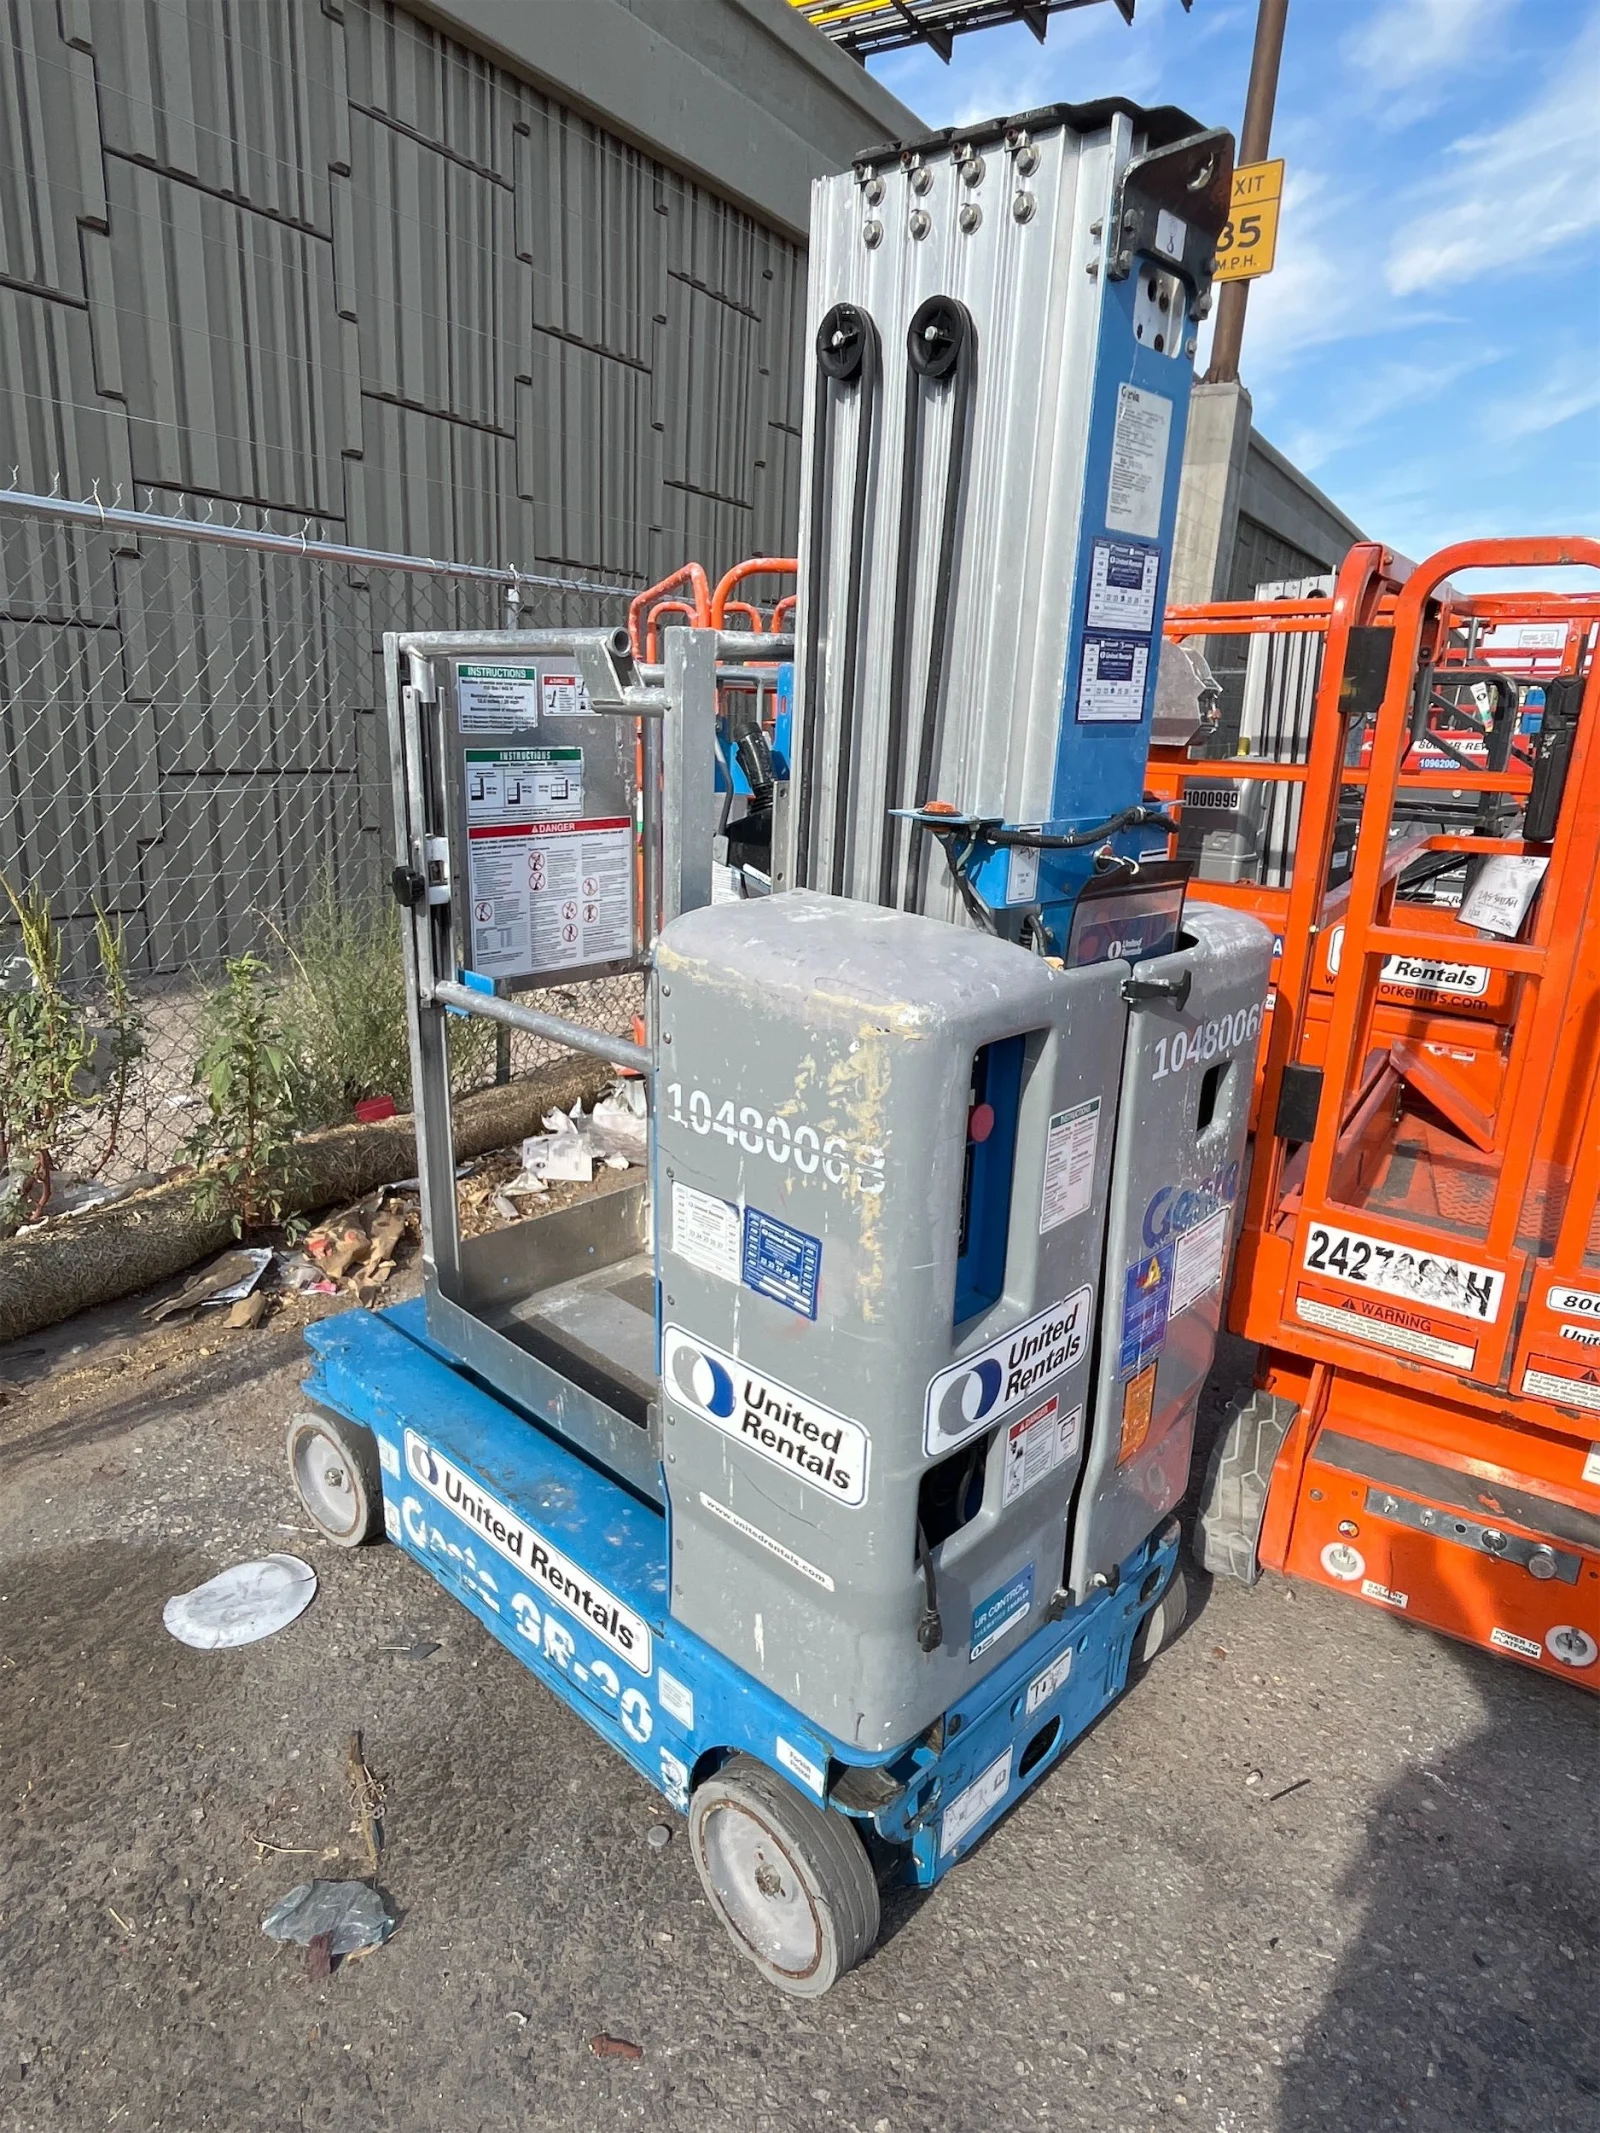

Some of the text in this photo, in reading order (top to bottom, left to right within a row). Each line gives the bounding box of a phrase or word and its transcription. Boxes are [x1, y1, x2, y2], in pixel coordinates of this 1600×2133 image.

[1233, 175, 1265, 197] XIT
[1215, 215, 1261, 252] 35
[467, 666, 526, 678] INSTRUCTIONS
[500, 751, 551, 760] INSTRUCTIONS
[539, 822, 576, 833] DANGER
[1394, 961, 1477, 986] Rentals
[1152, 1001, 1262, 1081] 1048006
[1307, 1230, 1494, 1316] 242H
[1361, 1302, 1432, 1332] WARNING
[1008, 1303, 1080, 1370] United
[1563, 1328, 1600, 1346] Unit
[1004, 1334, 1081, 1402] Rentals
[743, 1380, 843, 1454] United
[741, 1412, 852, 1490] Rentals
[706, 1499, 826, 1584] www.unitedrentals.com
[444, 1470, 634, 1652] United Rentals
[974, 1582, 1025, 1629] UR CONTROL
[1493, 1635, 1538, 1657] PLATFORM
[1495, 1629, 1540, 1650] POWER TO
[789, 1751, 812, 1773] Forklift
